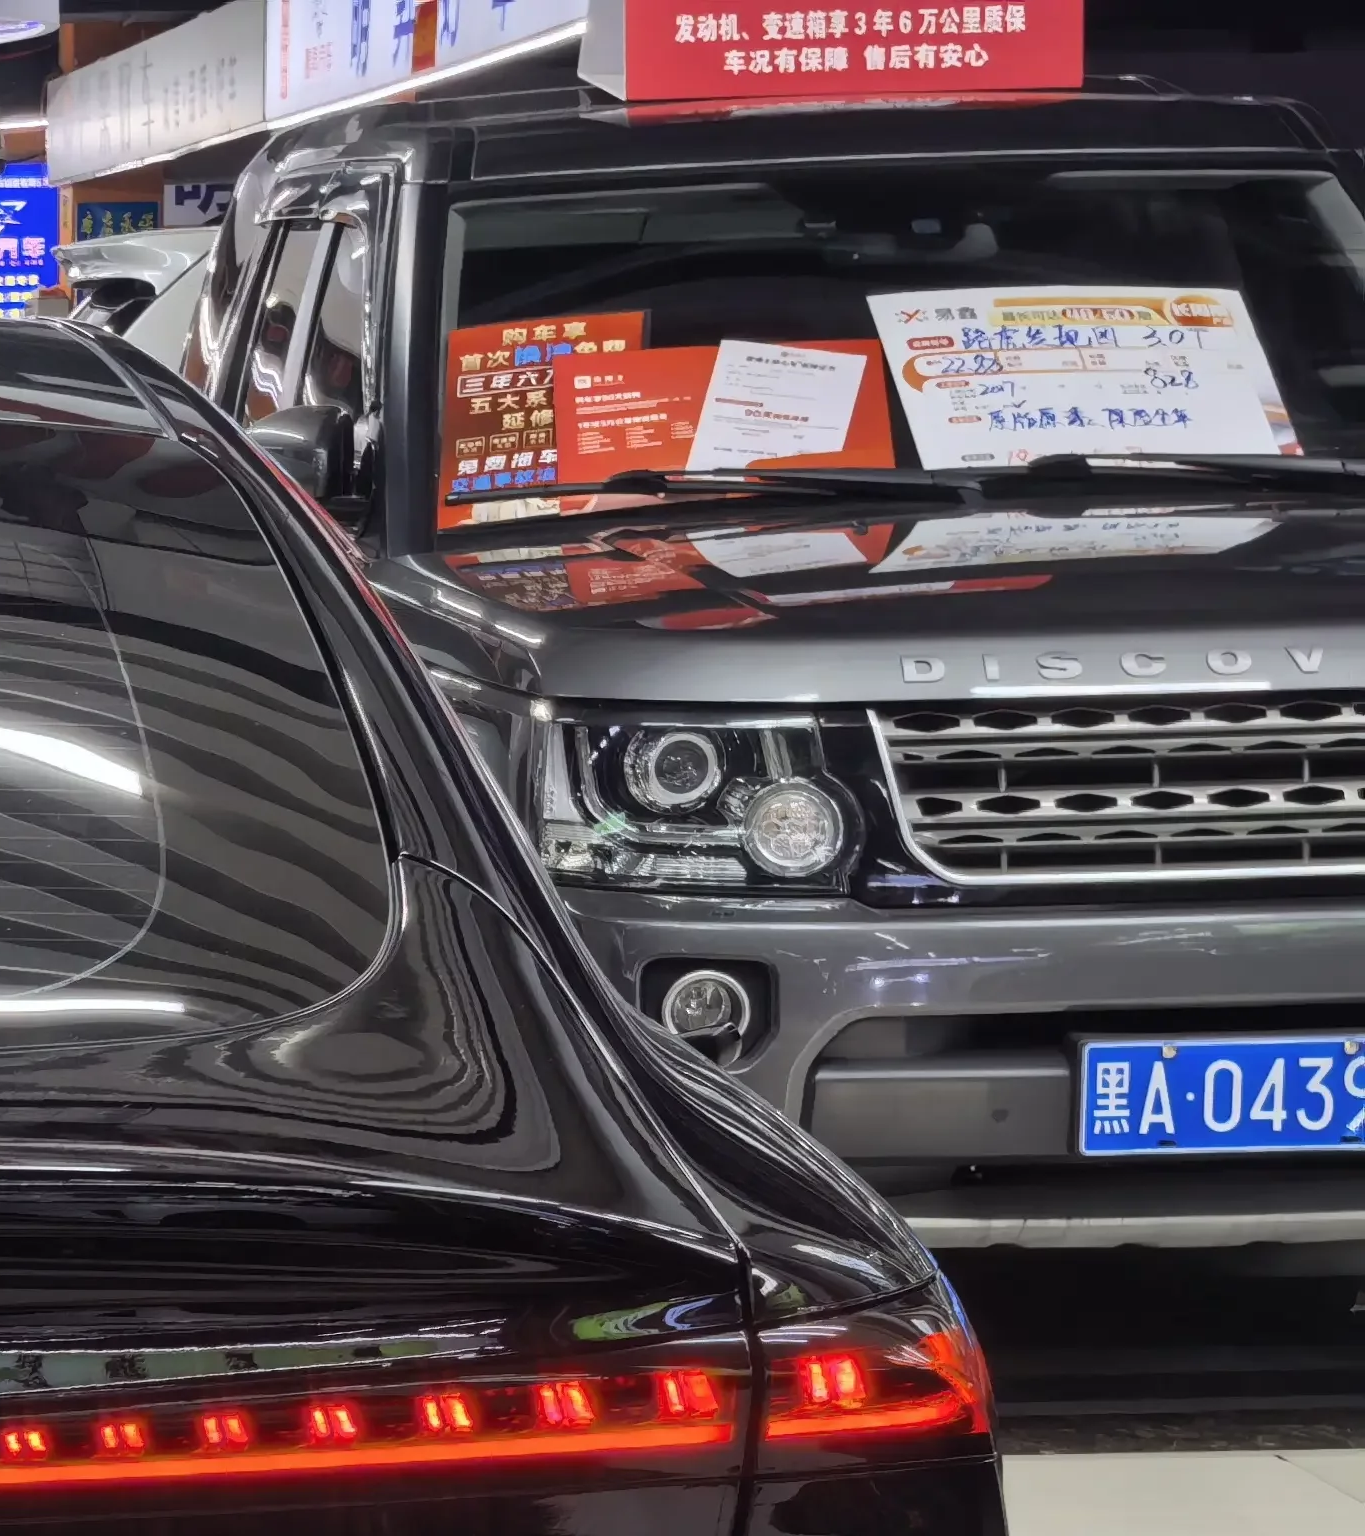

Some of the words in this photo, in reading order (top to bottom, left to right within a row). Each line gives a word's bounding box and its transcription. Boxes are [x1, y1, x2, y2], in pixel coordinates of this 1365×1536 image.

[723, 46, 849, 75] 车况有保障
[864, 43, 989, 72] 售后有安心
[900, 646, 1324, 683] DISCOV
